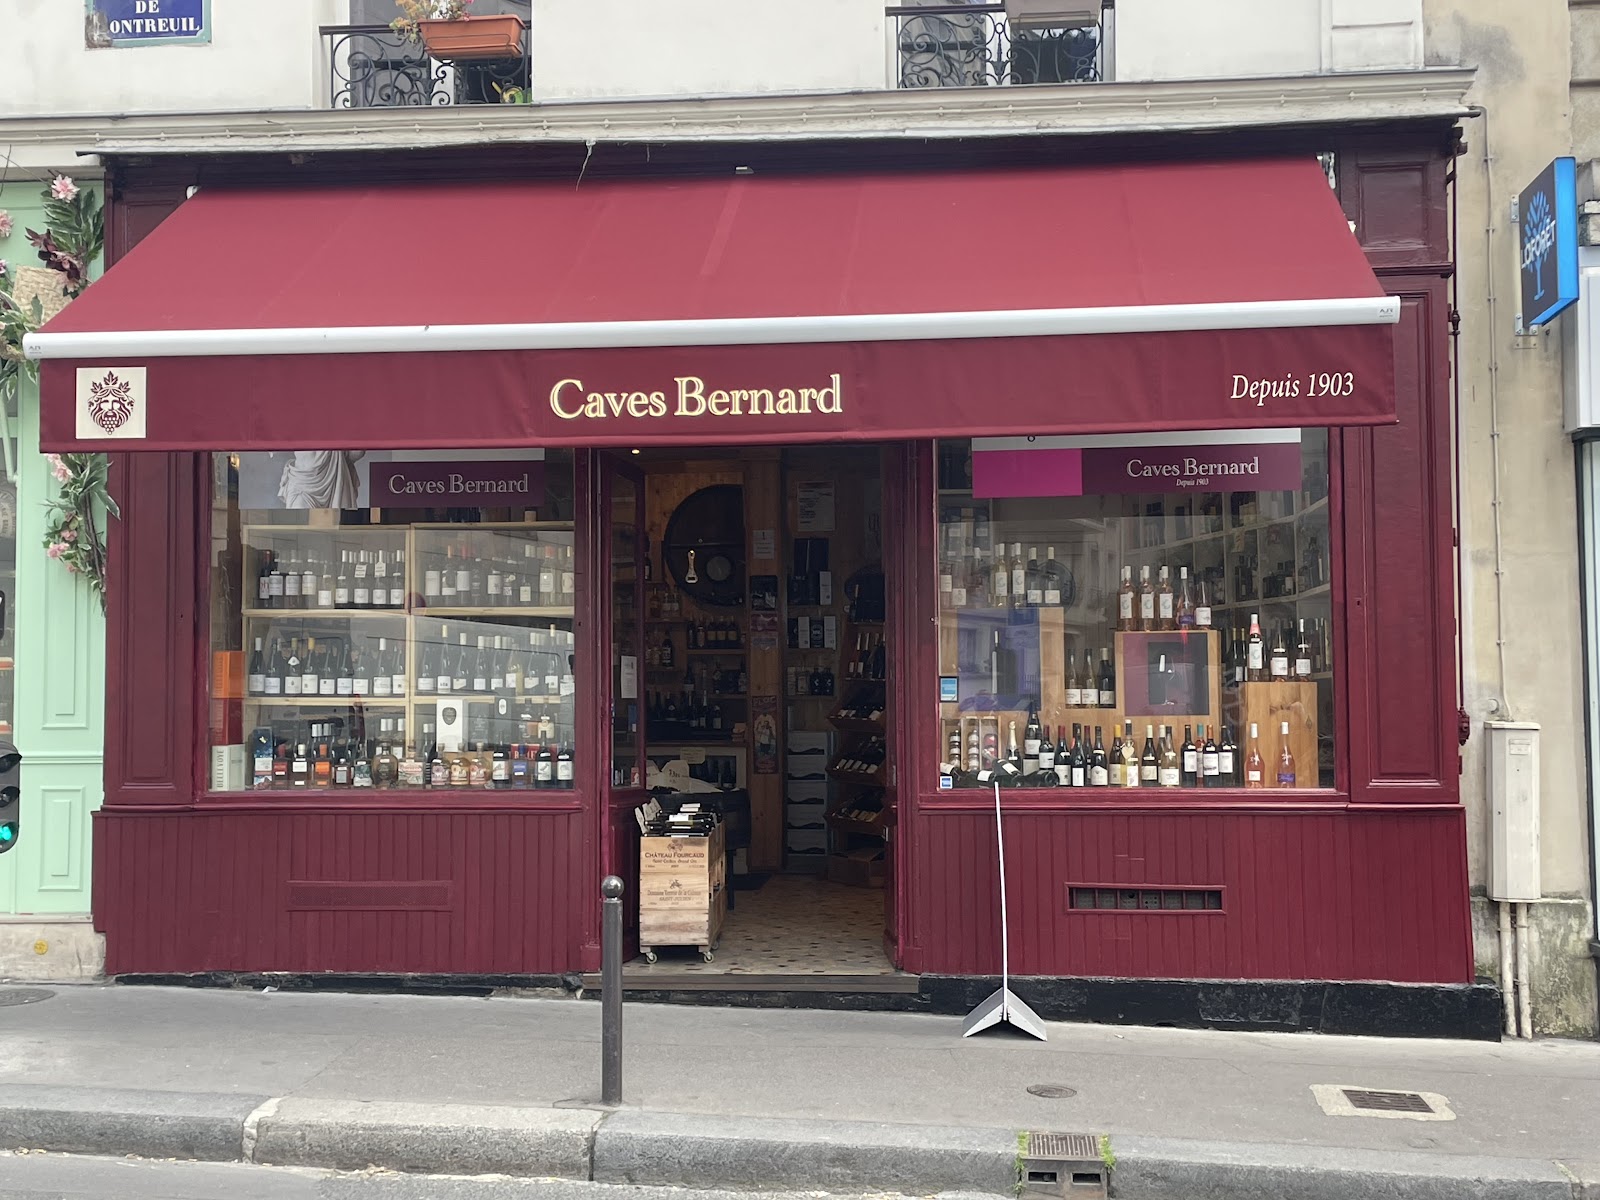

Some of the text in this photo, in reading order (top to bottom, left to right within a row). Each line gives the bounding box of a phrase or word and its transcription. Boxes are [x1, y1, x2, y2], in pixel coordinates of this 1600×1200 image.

[135, 0, 160, 14] DE
[108, 17, 200, 34] ONTREUIL
[549, 373, 843, 419] Caves Bernard
[1230, 372, 1354, 407] Depuis 1903
[1126, 456, 1260, 478] Caves Bernard
[388, 473, 529, 494] Caves Bernard
[1176, 478, 1195, 488] Depuis
